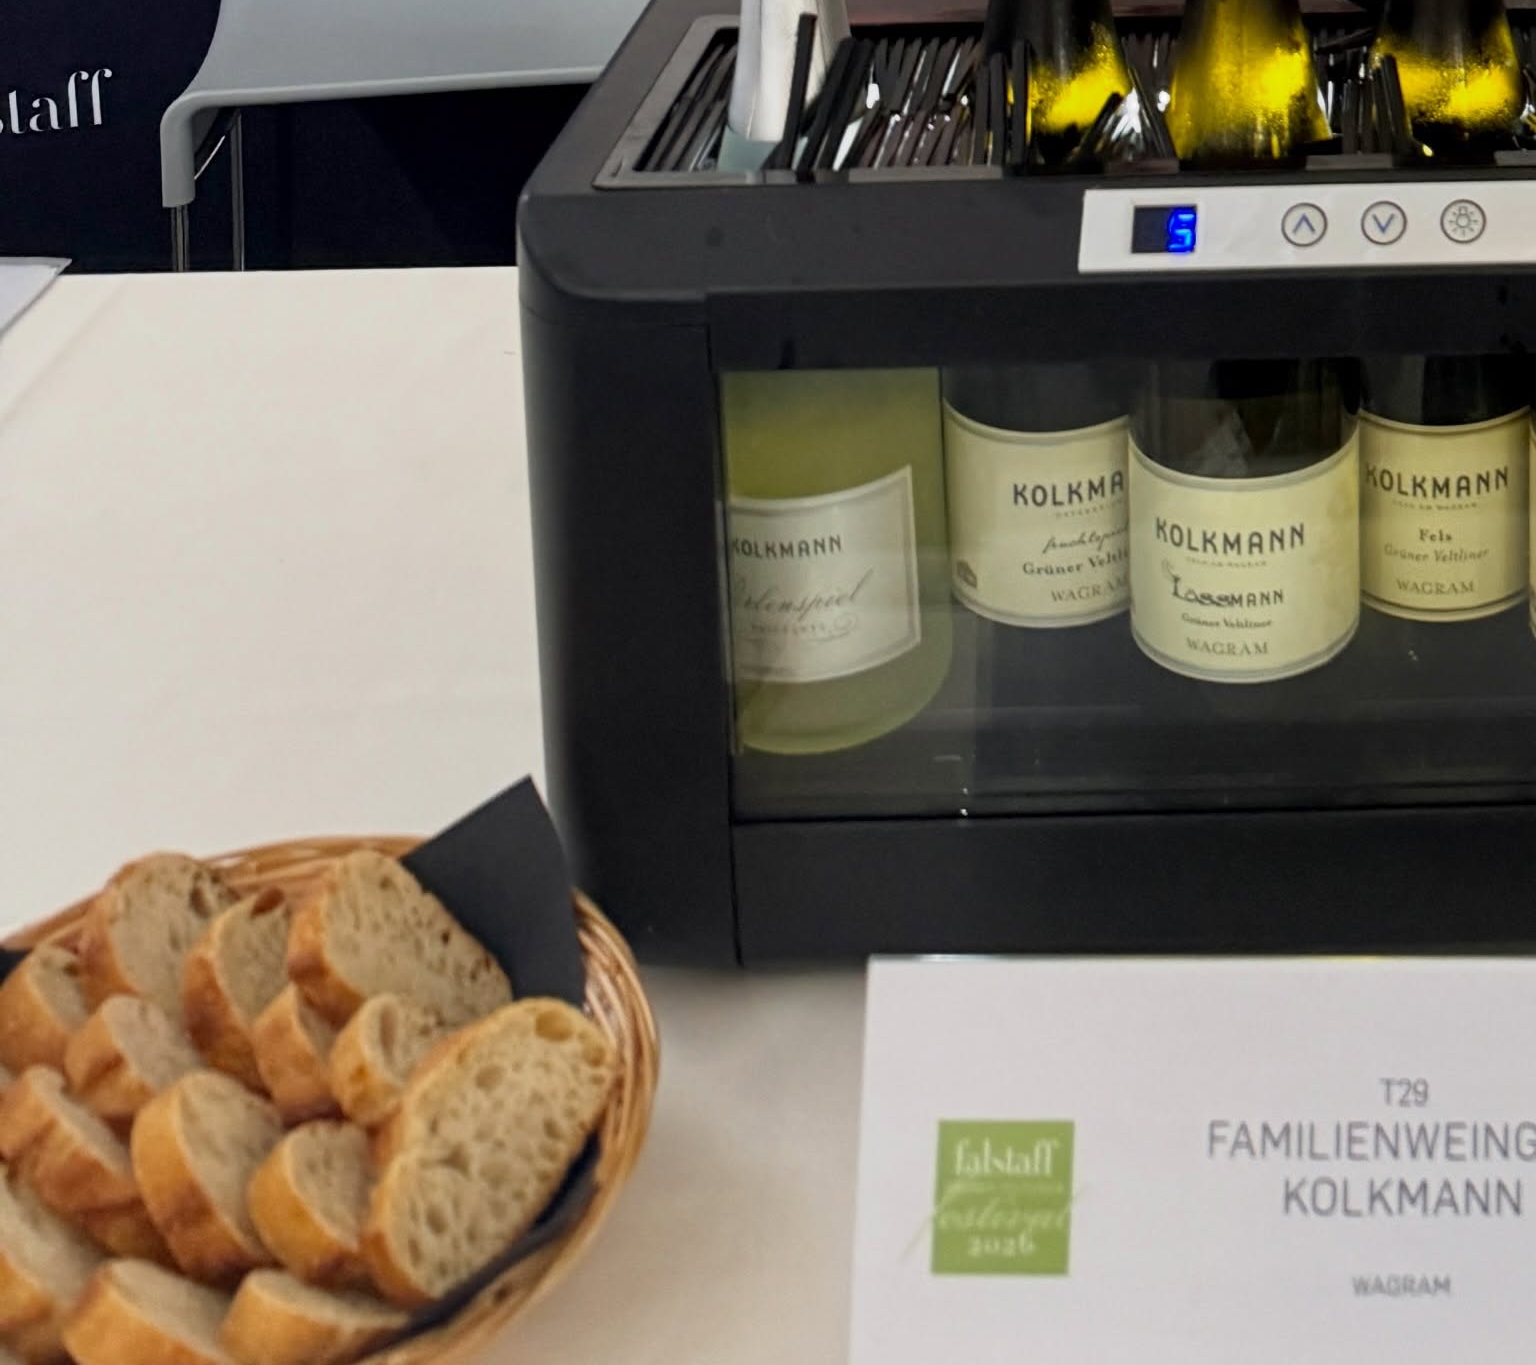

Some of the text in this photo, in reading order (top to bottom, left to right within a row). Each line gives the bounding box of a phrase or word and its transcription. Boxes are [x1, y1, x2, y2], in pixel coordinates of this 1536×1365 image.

[1168, 211, 1196, 251] 5
[1366, 462, 1508, 498] KOLKMANN
[1156, 517, 1305, 556] KOLKMANN
[1419, 528, 1452, 542] Fels
[1023, 562, 1083, 575] Grüner
[1396, 578, 1474, 595] WAGRAM
[1186, 637, 1268, 655] WAGRAM
[1380, 1078, 1429, 1106] T29
[955, 1137, 1060, 1177] falstaff
[1282, 1177, 1523, 1217] KOLKMANN
[1352, 1275, 1452, 1297] WAGRAM
